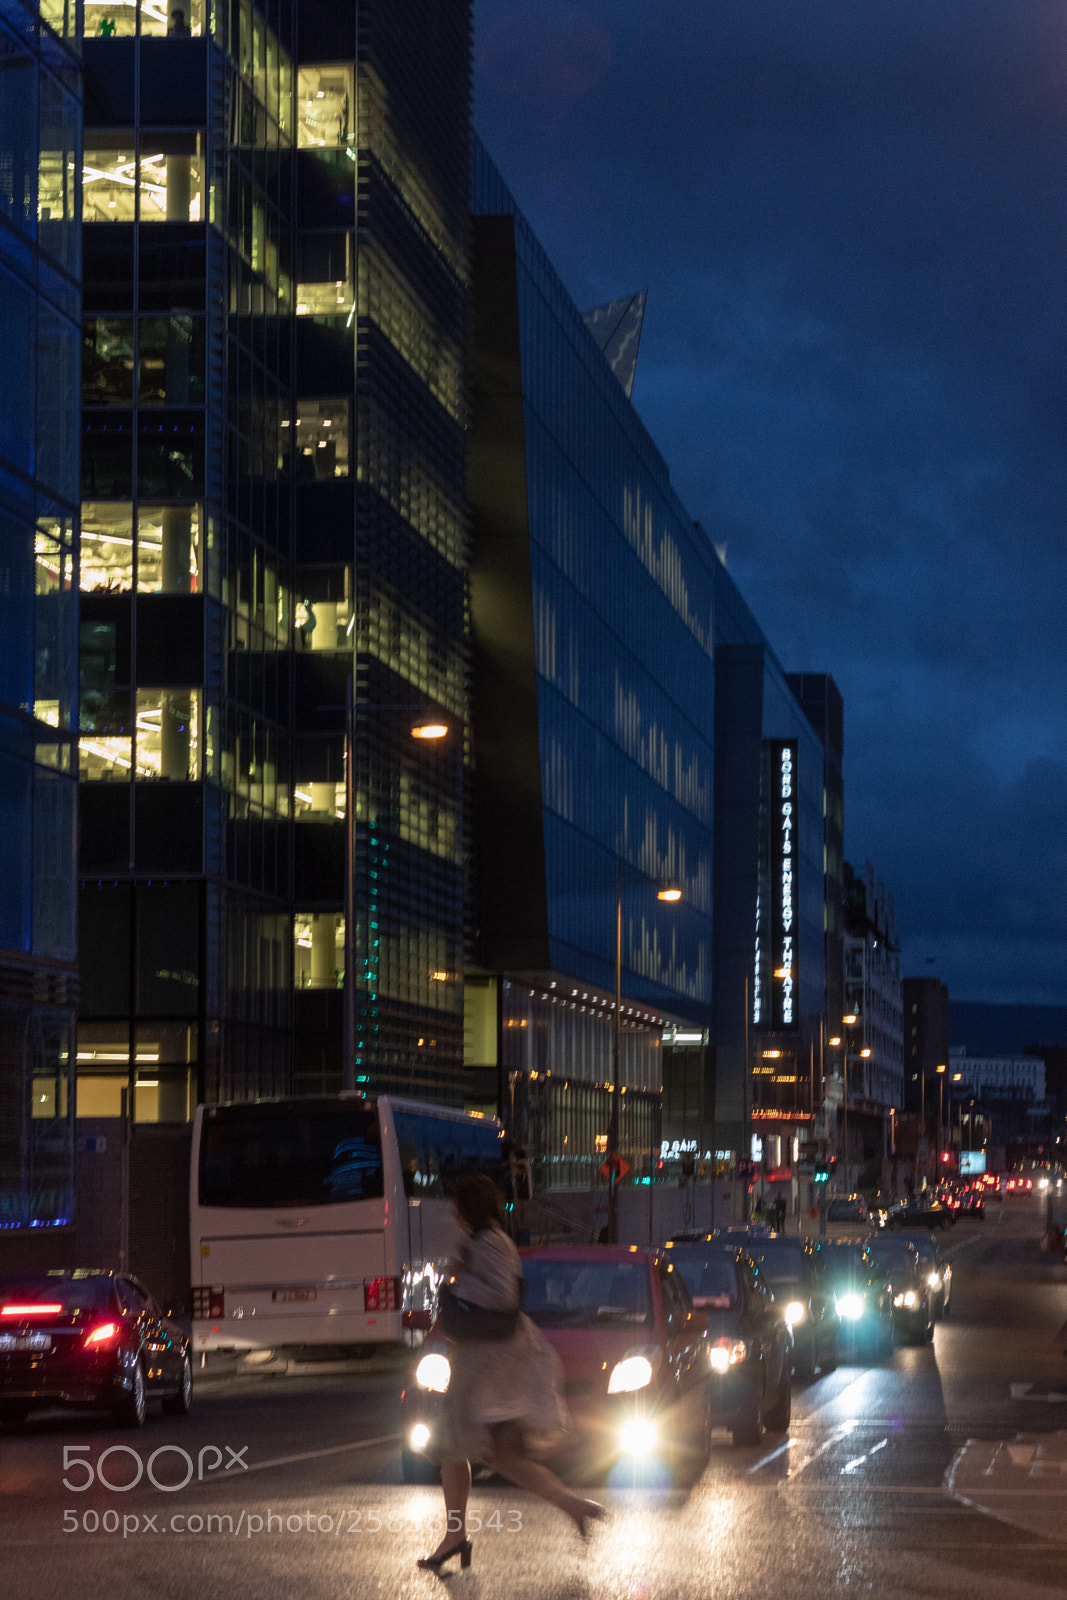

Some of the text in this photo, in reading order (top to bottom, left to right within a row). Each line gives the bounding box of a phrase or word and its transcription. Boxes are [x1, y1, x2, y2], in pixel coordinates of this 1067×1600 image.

[781, 748, 793, 798] BORD
[782, 857, 793, 932] ENERGY
[782, 936, 793, 1024] THEATRE
